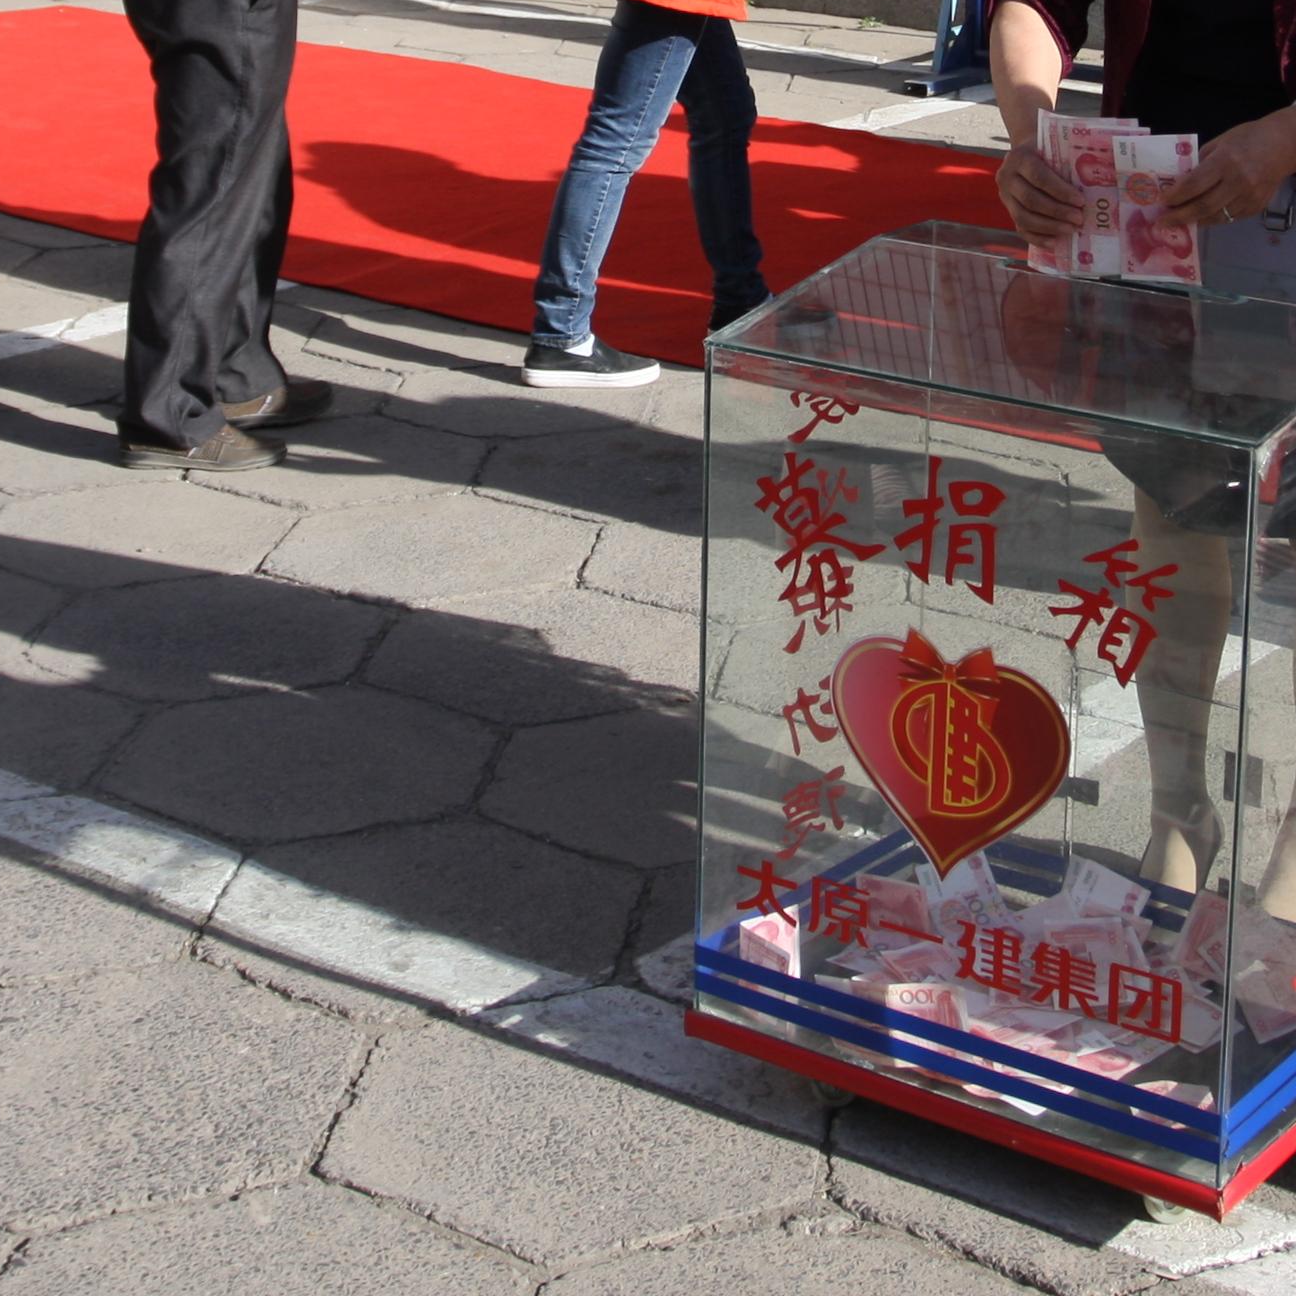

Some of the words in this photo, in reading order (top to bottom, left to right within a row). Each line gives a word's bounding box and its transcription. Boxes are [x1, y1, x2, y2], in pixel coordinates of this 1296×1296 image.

[736, 860, 1183, 1044] 太原一建集团
